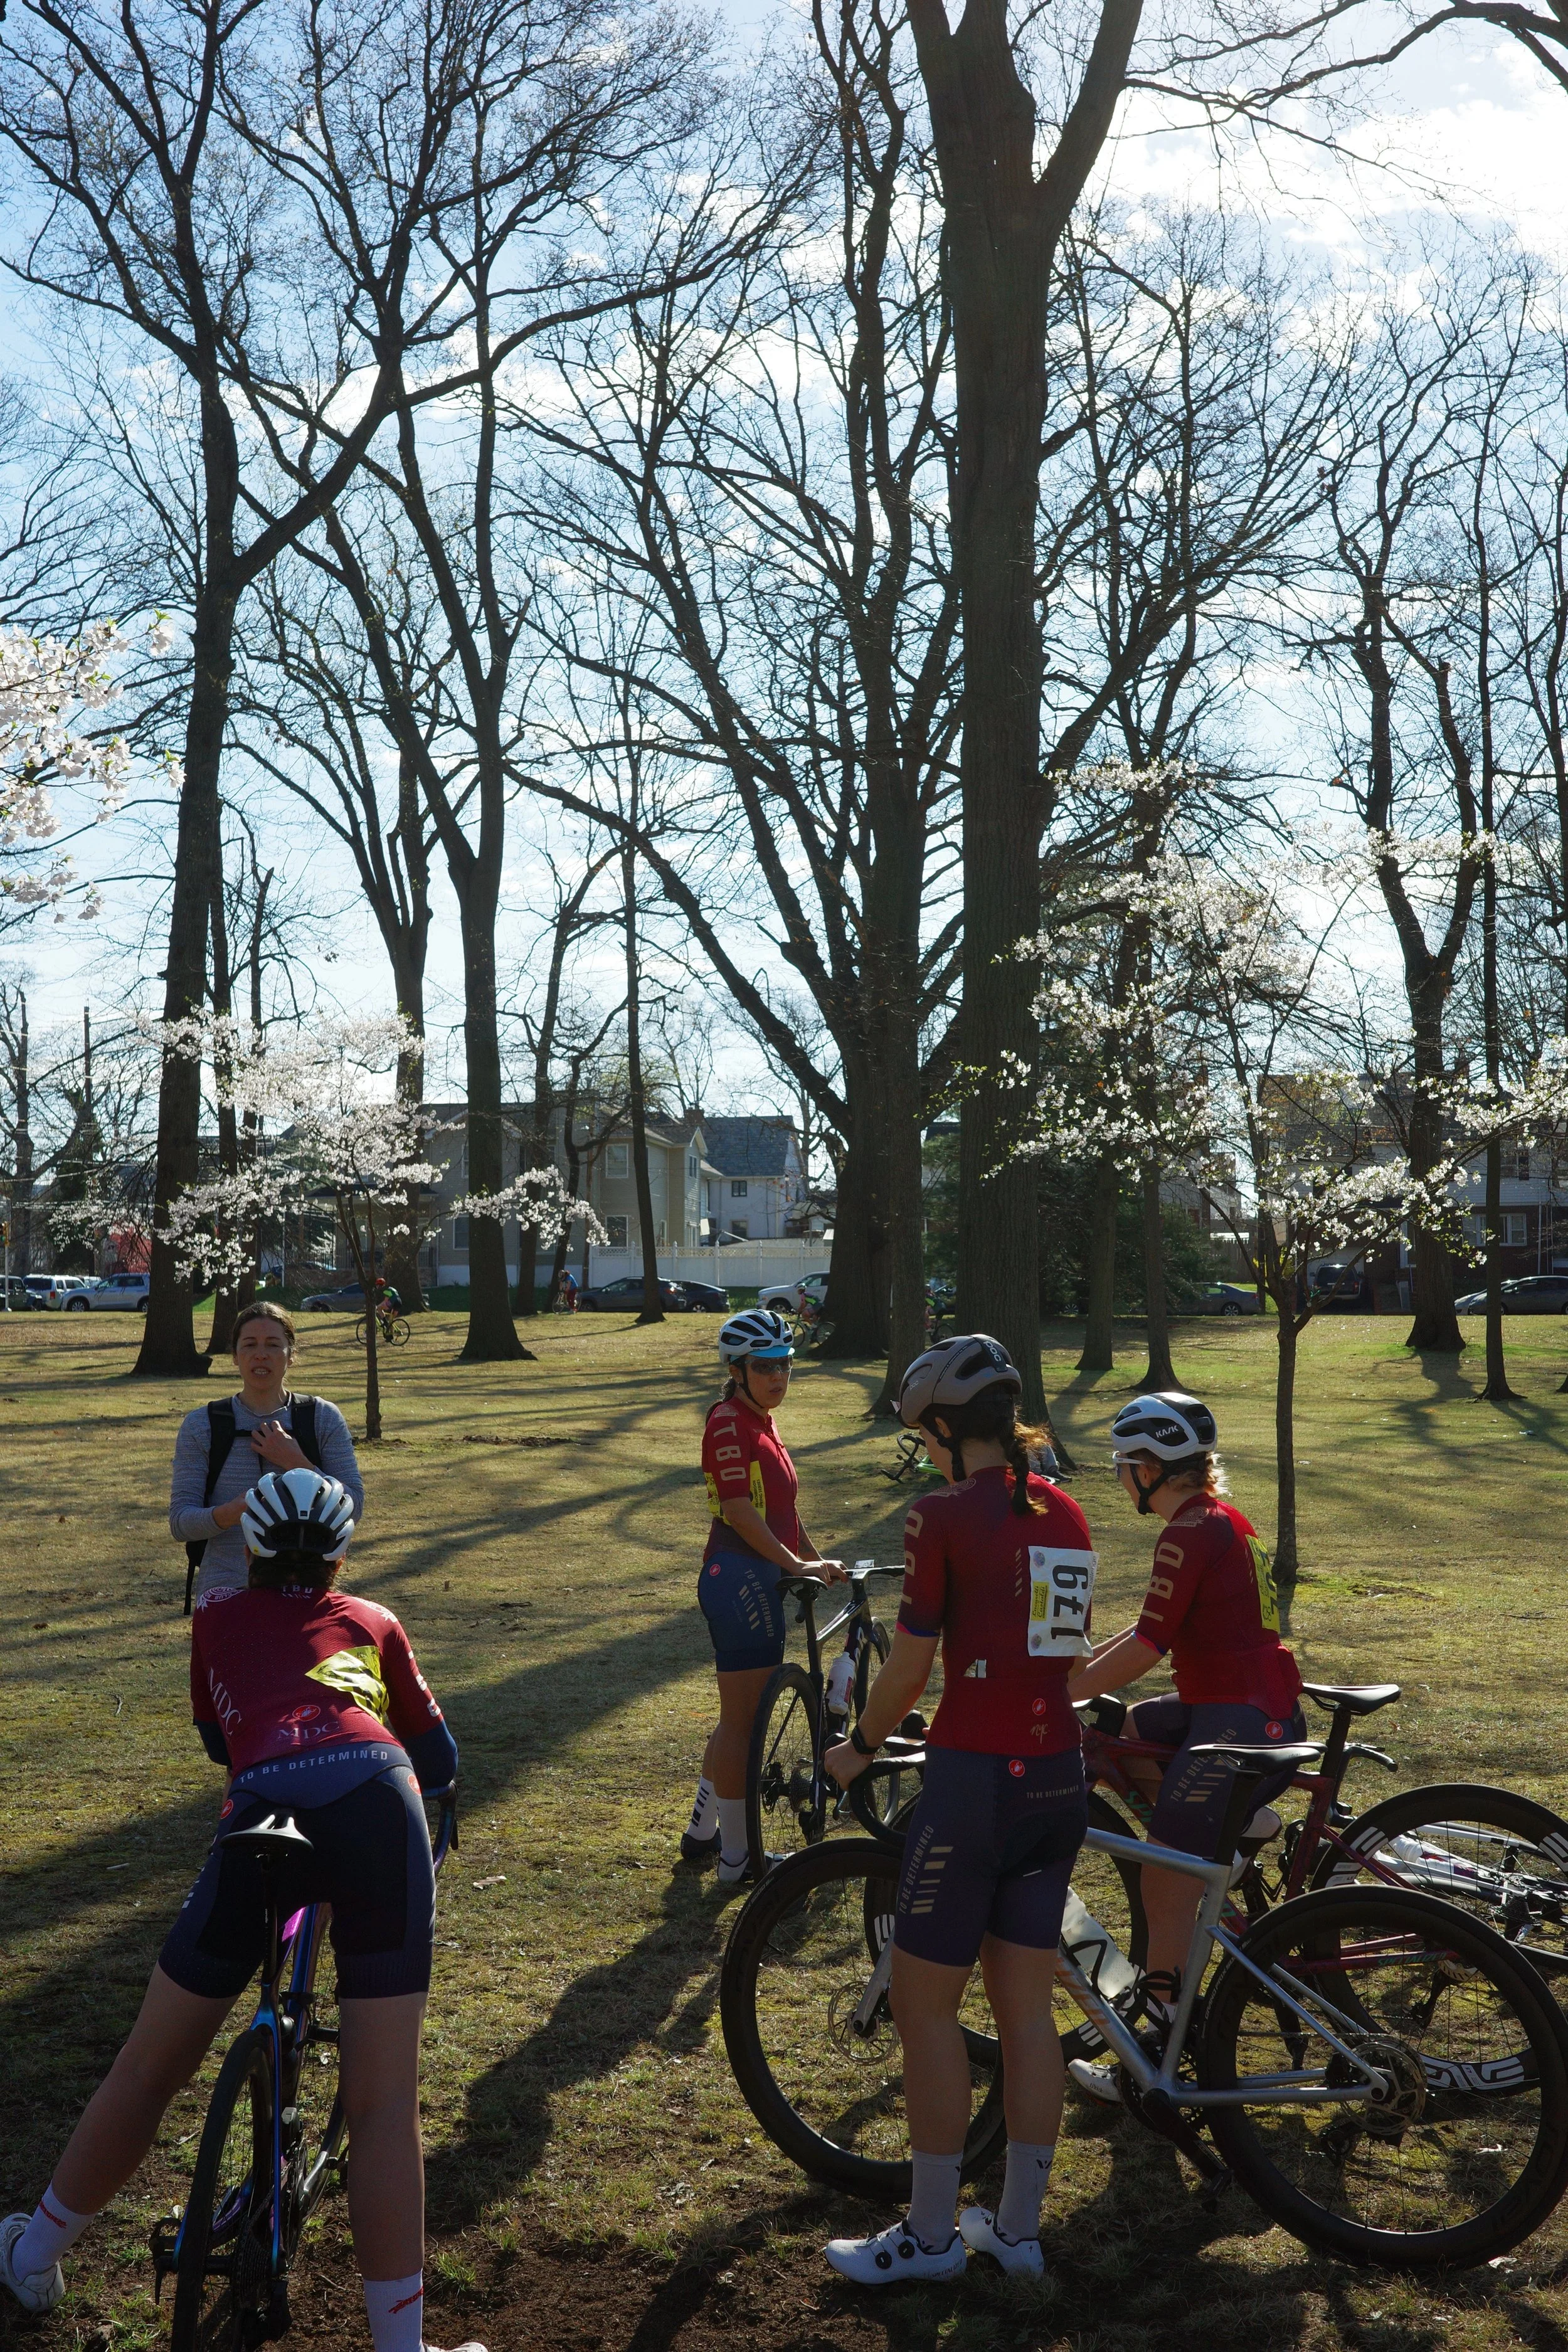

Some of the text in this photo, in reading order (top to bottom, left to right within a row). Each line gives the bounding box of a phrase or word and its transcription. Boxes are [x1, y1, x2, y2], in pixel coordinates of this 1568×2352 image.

[1155, 1425, 1179, 1438] KASK
[744, 1569, 775, 1638] TO BE DETERMINED
[1051, 1564, 1089, 1640] 179
[208, 1666, 243, 1737] MDC
[278, 1721, 339, 1739] MDC
[240, 1750, 388, 1784] TO BE DETERMINED
[1036, 1791, 1043, 1799] BE
[1045, 1784, 1079, 1798] DETERMINED
[1170, 1728, 1237, 1802] TO BE DETENED
[899, 1825, 935, 1914] TO BE DETERMINED
